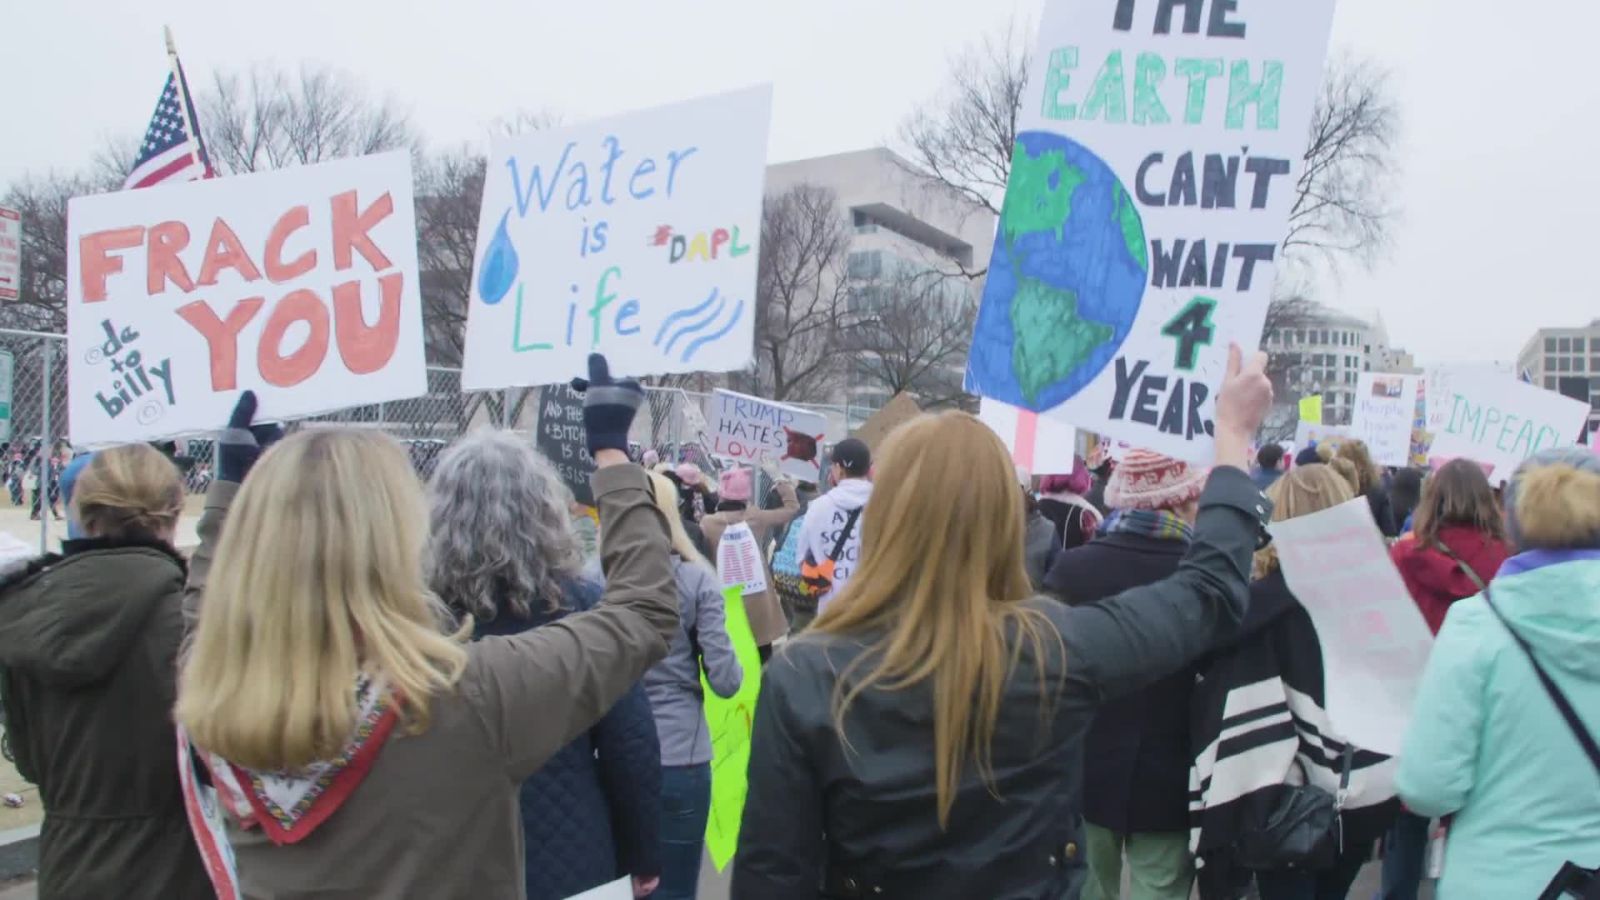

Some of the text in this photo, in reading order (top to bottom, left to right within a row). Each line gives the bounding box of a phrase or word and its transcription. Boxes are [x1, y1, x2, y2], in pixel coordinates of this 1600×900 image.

[1041, 46, 1285, 131] EARTH
[506, 135, 698, 219] Water
[1134, 146, 1291, 210] CAN'T
[79, 188, 394, 303] FRACK
[580, 217, 609, 258] is
[1150, 238, 1277, 292] WAIT
[175, 271, 404, 393] YOU
[511, 266, 641, 353] Life
[1160, 295, 1219, 372] 4
[95, 358, 175, 420] billy
[111, 350, 142, 373] to
[719, 393, 794, 427] TRUMP
[719, 418, 784, 448] HATES
